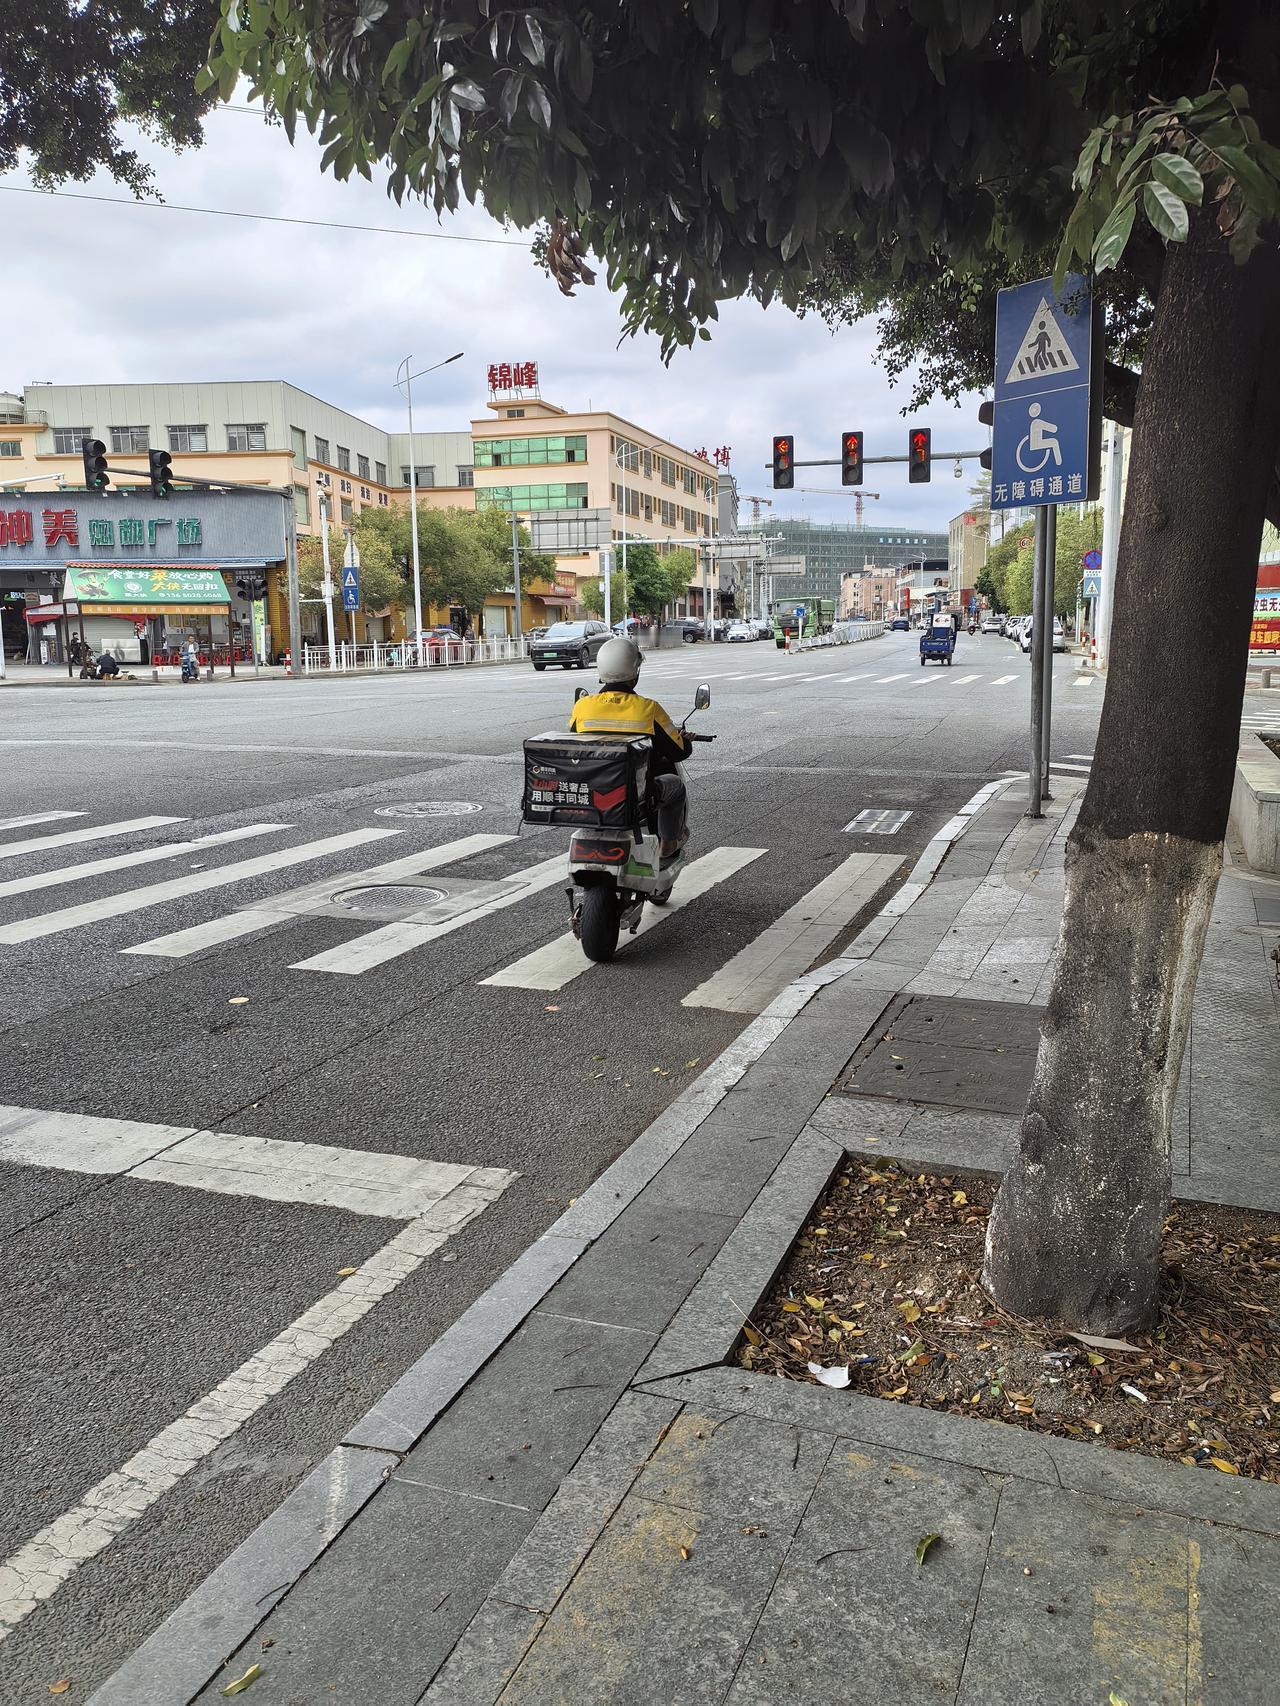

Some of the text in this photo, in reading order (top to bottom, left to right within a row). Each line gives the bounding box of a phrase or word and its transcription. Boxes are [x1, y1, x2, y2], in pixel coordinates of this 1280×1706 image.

[488, 362, 538, 390] 锦峰
[995, 472, 1082, 503] 无障碍通道
[88, 518, 202, 546] 购物广场
[532, 790, 589, 805] 用顺丰同城
